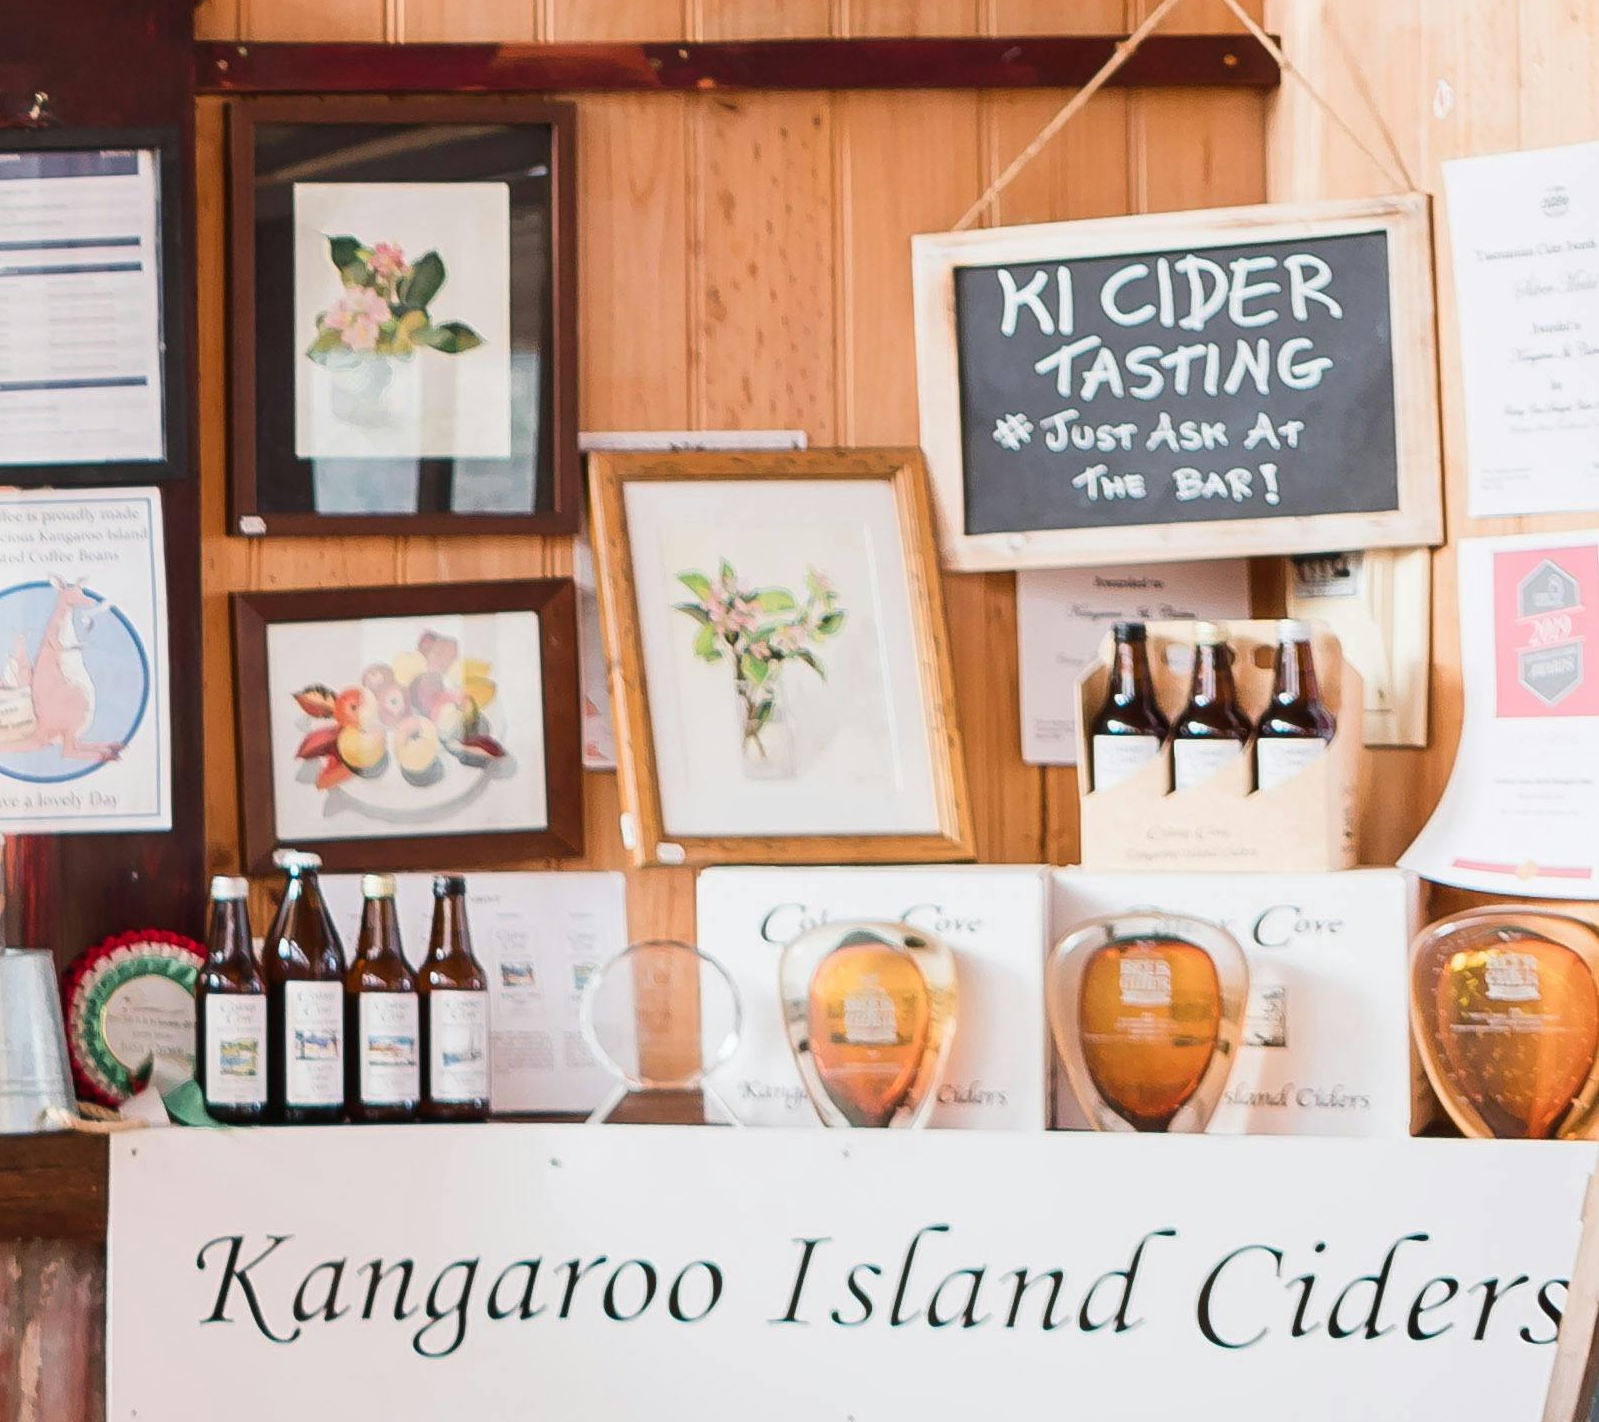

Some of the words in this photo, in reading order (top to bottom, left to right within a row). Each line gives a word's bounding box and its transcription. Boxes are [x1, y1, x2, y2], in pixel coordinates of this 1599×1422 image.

[997, 265, 1074, 337] KI
[1100, 253, 1343, 331] CIDER
[1035, 335, 1334, 402] TASTING
[27, 511, 37, 522] is
[42, 506, 96, 526] proudly
[102, 507, 139, 521] made
[40, 530, 103, 545] Kangaroo
[107, 527, 148, 540] Island
[29, 549, 74, 563] Coffee
[78, 548, 119, 563] Beans
[24, 797, 33, 807] a
[37, 791, 83, 811] lovely
[91, 791, 118, 810] Day
[1252, 905, 1343, 947] Cove
[937, 1080, 1008, 1105] Ciders
[1225, 1082, 1290, 1106] sland
[1296, 1082, 1371, 1109] Ciders
[194, 1230, 726, 1358] Kangaroo
[765, 1220, 1180, 1338] Island
[1193, 1229, 1572, 1352] Ciders
